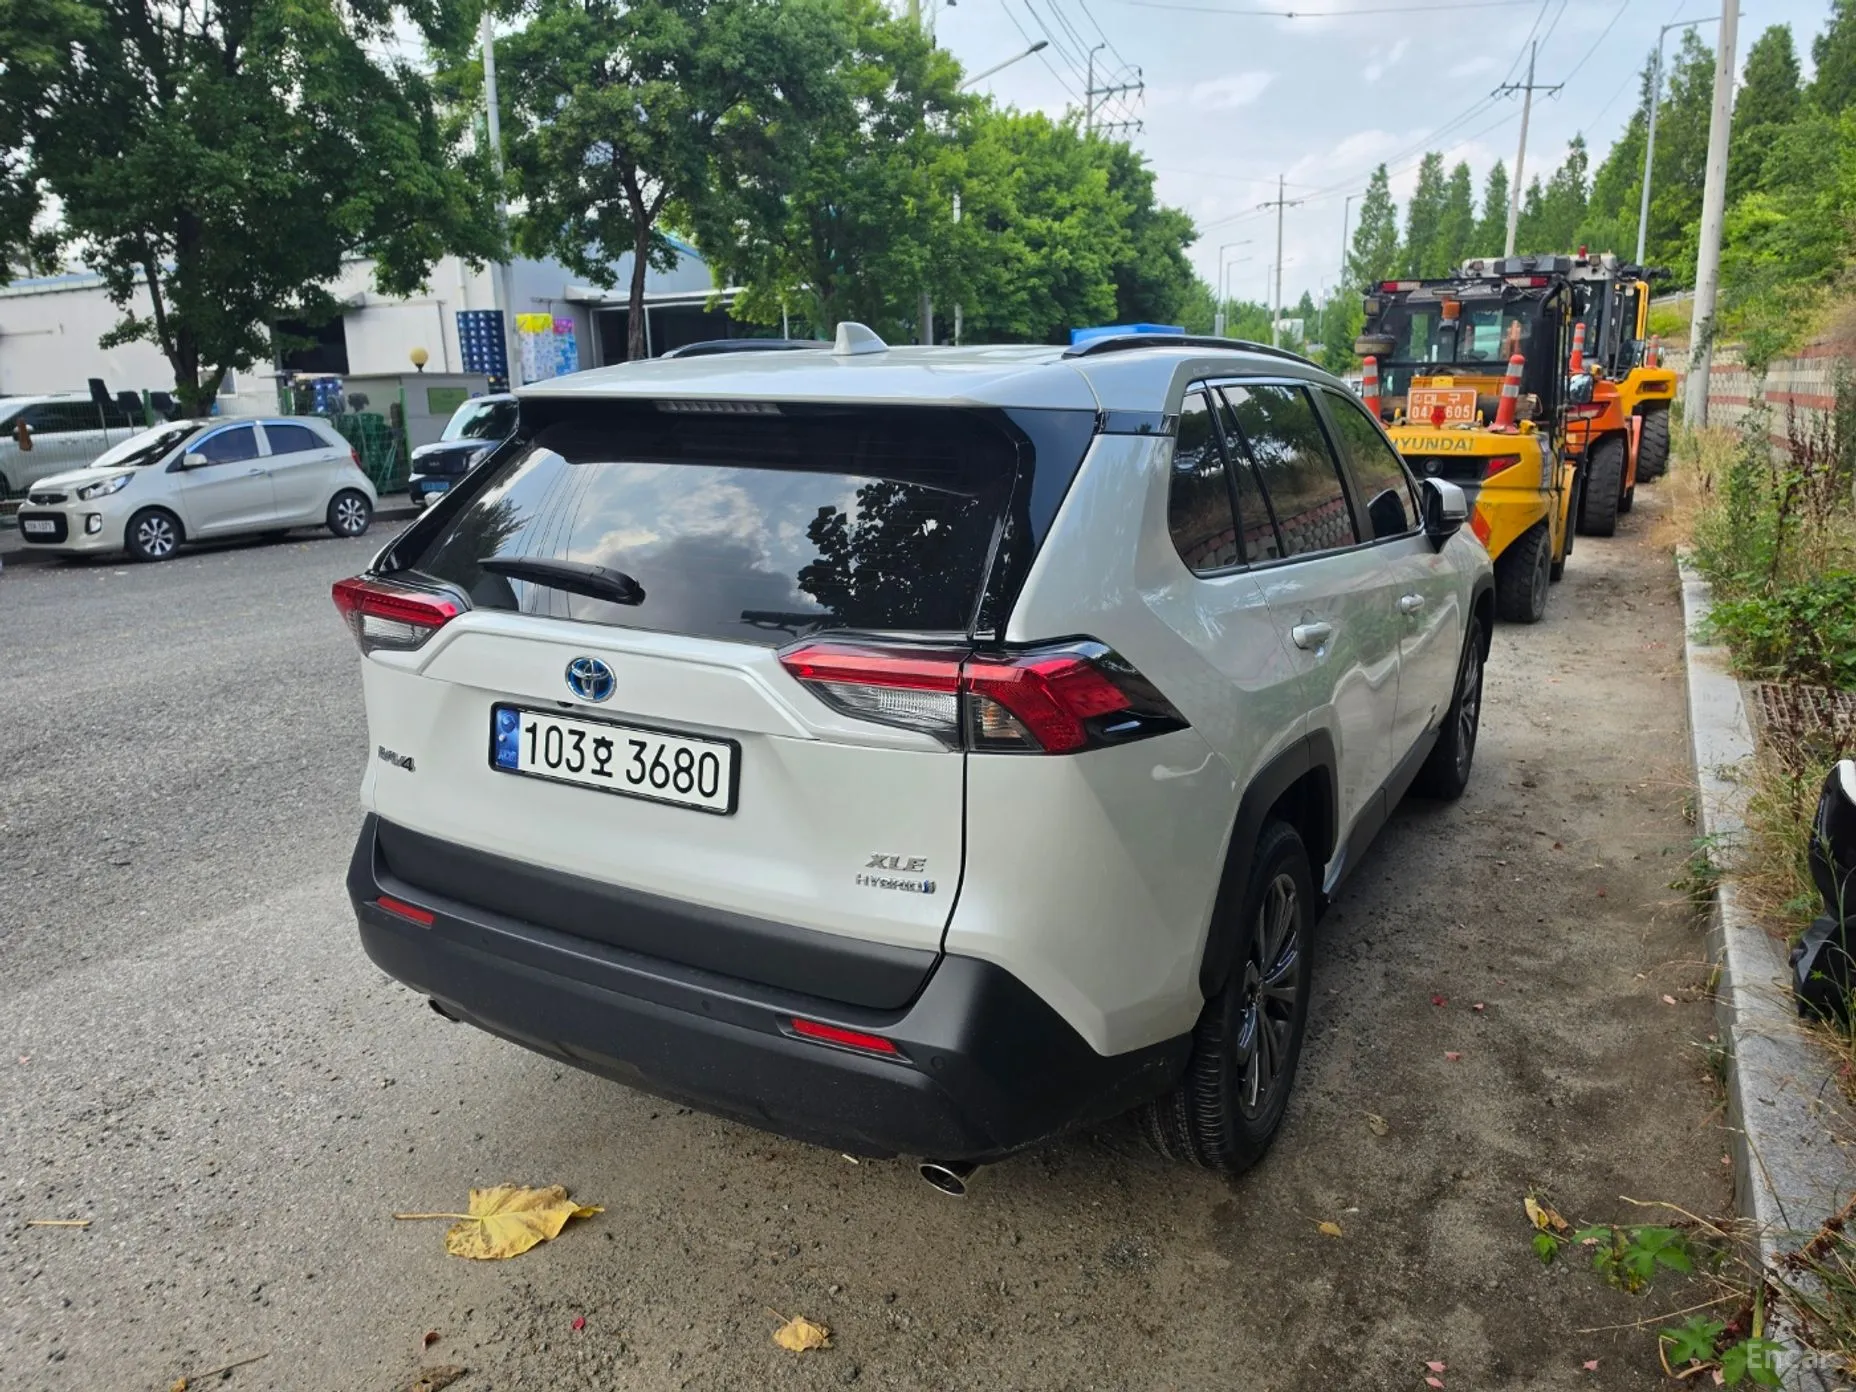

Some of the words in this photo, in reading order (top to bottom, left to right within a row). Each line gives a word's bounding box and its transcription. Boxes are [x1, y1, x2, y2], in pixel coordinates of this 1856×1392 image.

[524, 722, 614, 778] 103호
[625, 738, 720, 798] 3680
[865, 853, 927, 873] XLE
[856, 873, 923, 893] HYBRID
